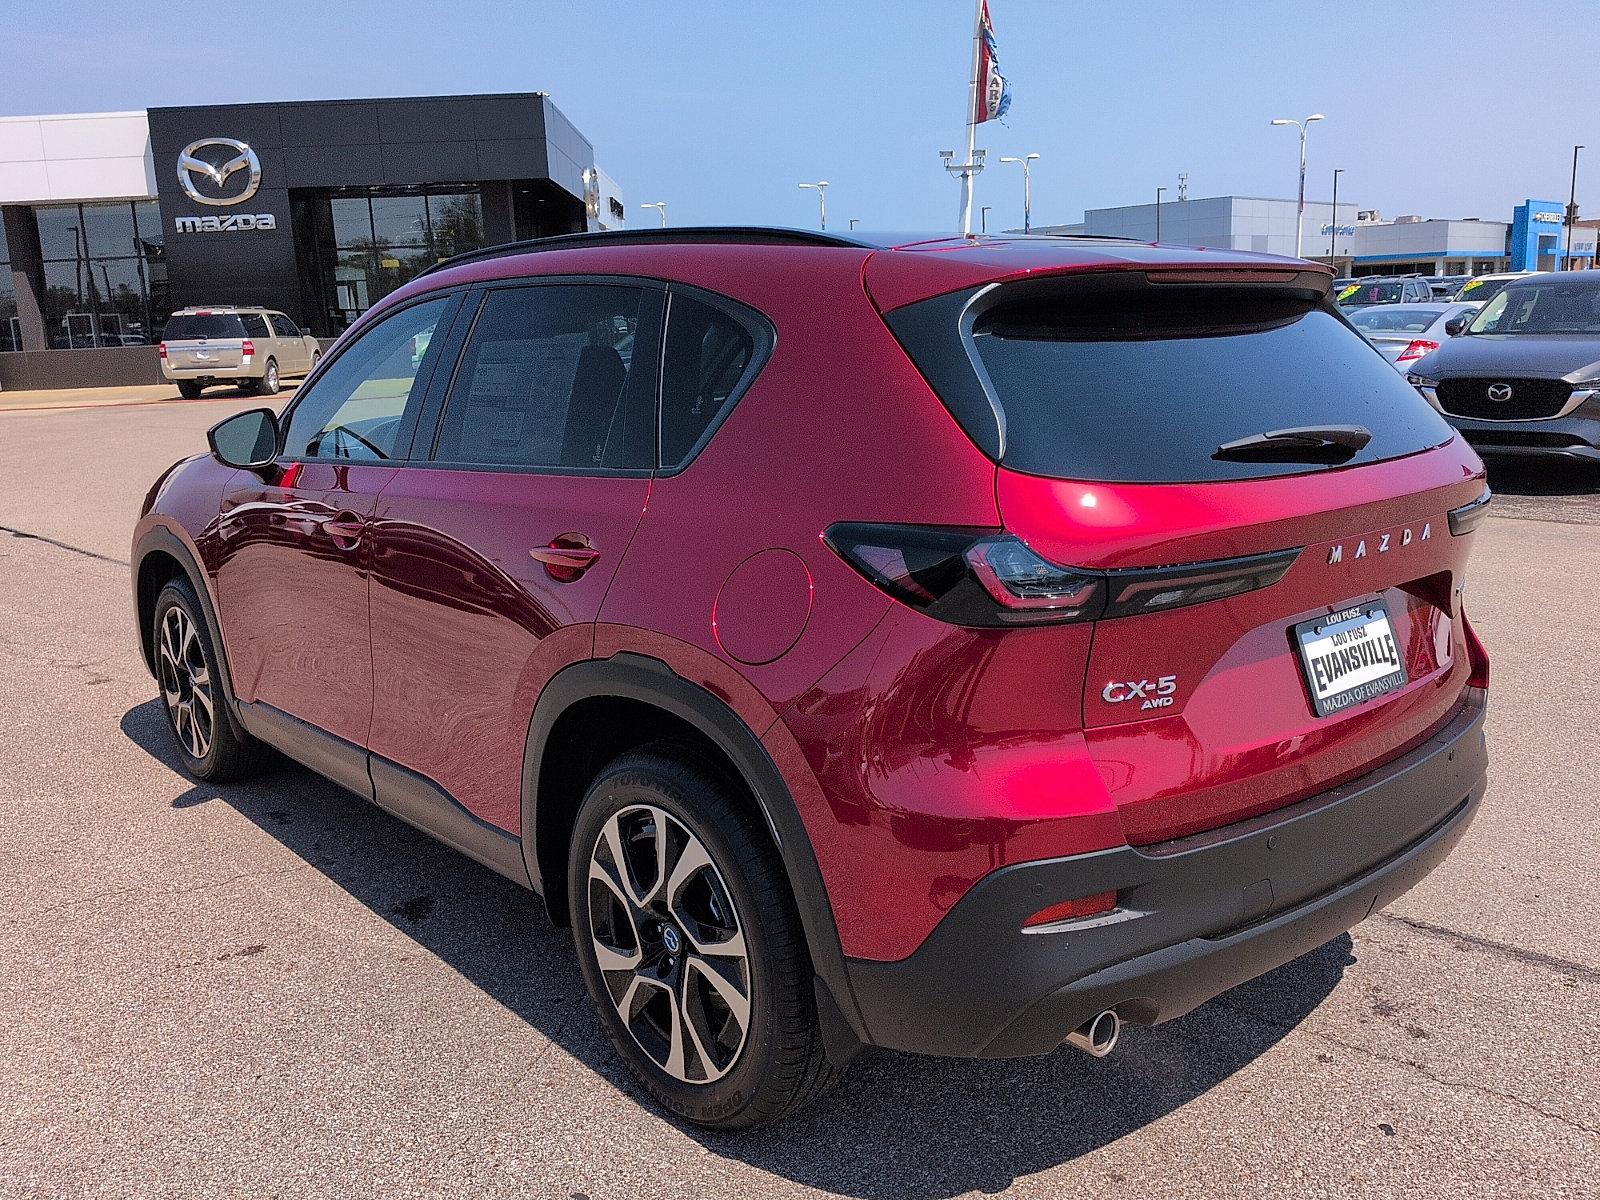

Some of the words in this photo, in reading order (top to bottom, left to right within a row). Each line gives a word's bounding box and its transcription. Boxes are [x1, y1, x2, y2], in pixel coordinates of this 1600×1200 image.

[1327, 523, 1431, 565] MAZDA
[1326, 615, 1342, 626] LOU
[1342, 607, 1361, 619] FUSZ
[1331, 633, 1348, 647] LOU
[1348, 626, 1367, 642] FUSZ
[1311, 634, 1397, 693] EVANSVILLE
[1102, 675, 1177, 703] CX-5
[1141, 697, 1174, 710] AWD
[1323, 692, 1355, 713] MAZDA
[1354, 687, 1367, 700] OF
[1366, 672, 1405, 696] EVANSVILLE
[700, 1088, 745, 1119] OPEN
